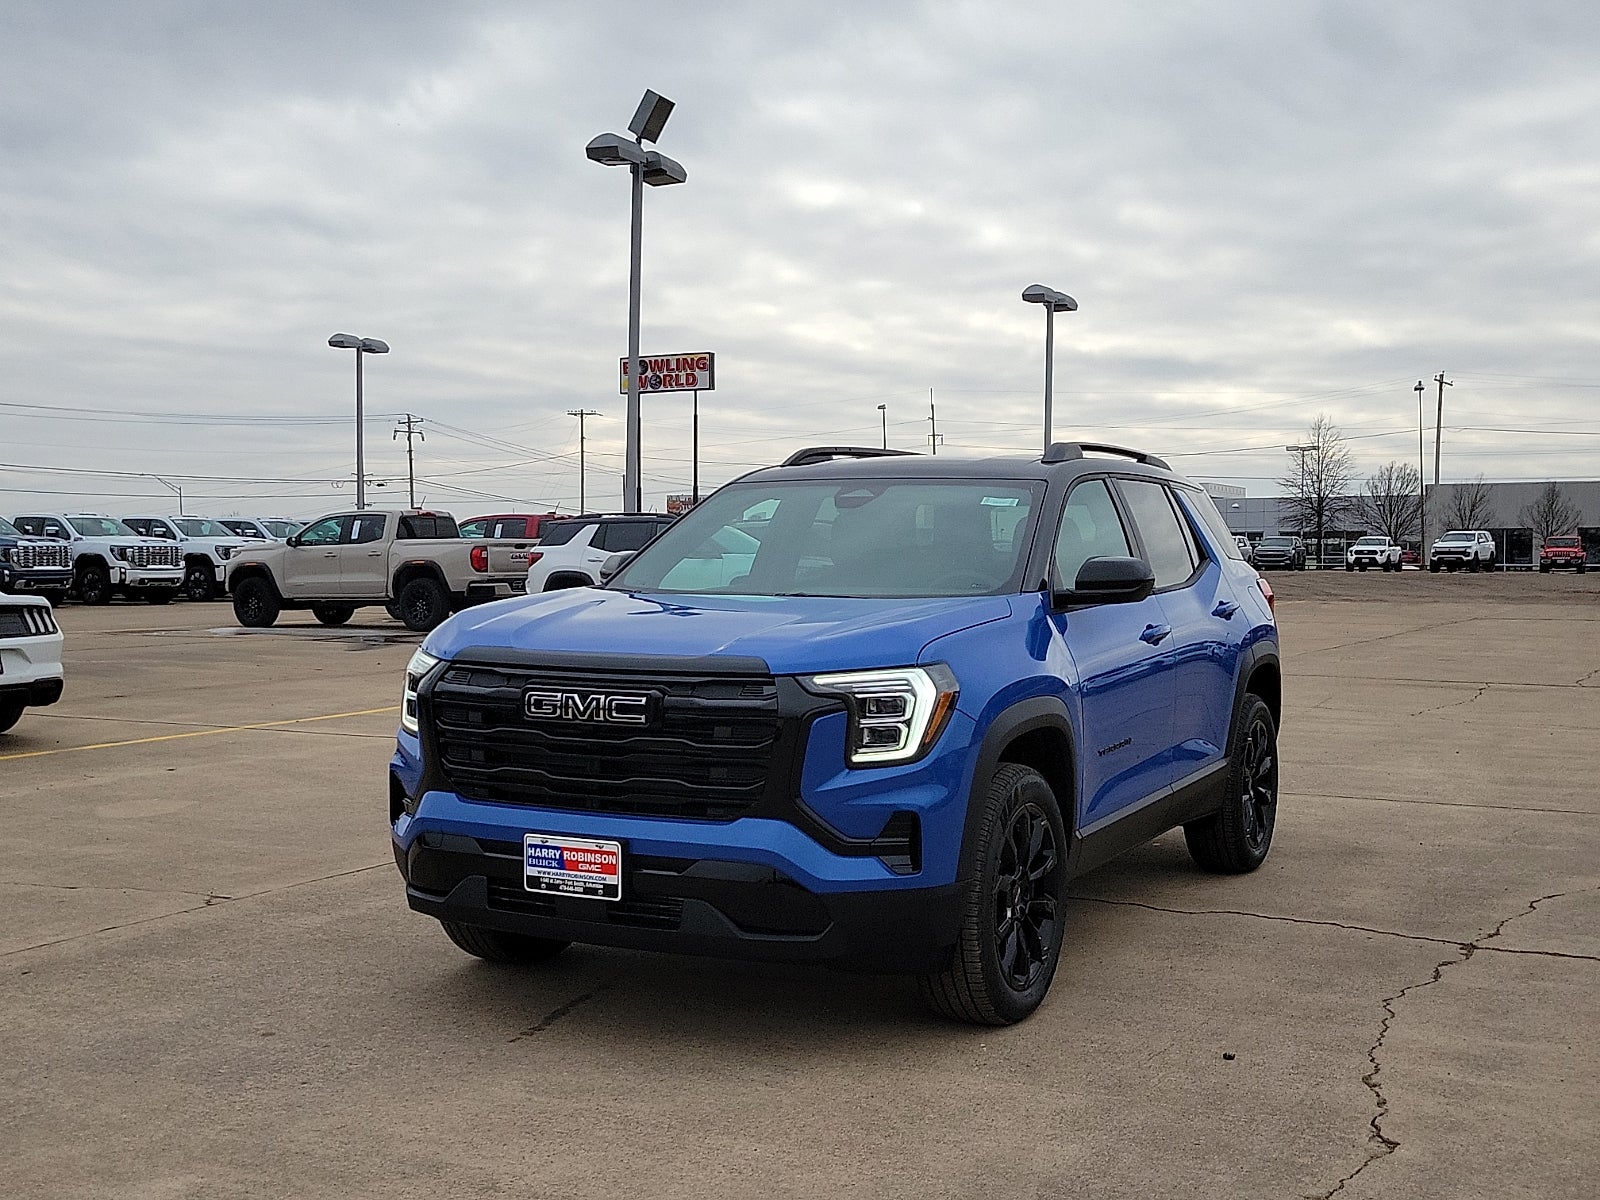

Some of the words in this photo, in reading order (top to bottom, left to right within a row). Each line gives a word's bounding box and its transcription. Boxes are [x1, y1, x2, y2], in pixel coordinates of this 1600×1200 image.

[638, 373, 698, 390] WORLD
[525, 691, 647, 723] GMC
[528, 847, 561, 860] HARRY
[563, 850, 617, 865] ROBINSON
[528, 857, 560, 868] BUICK
[578, 863, 602, 872] GMC
